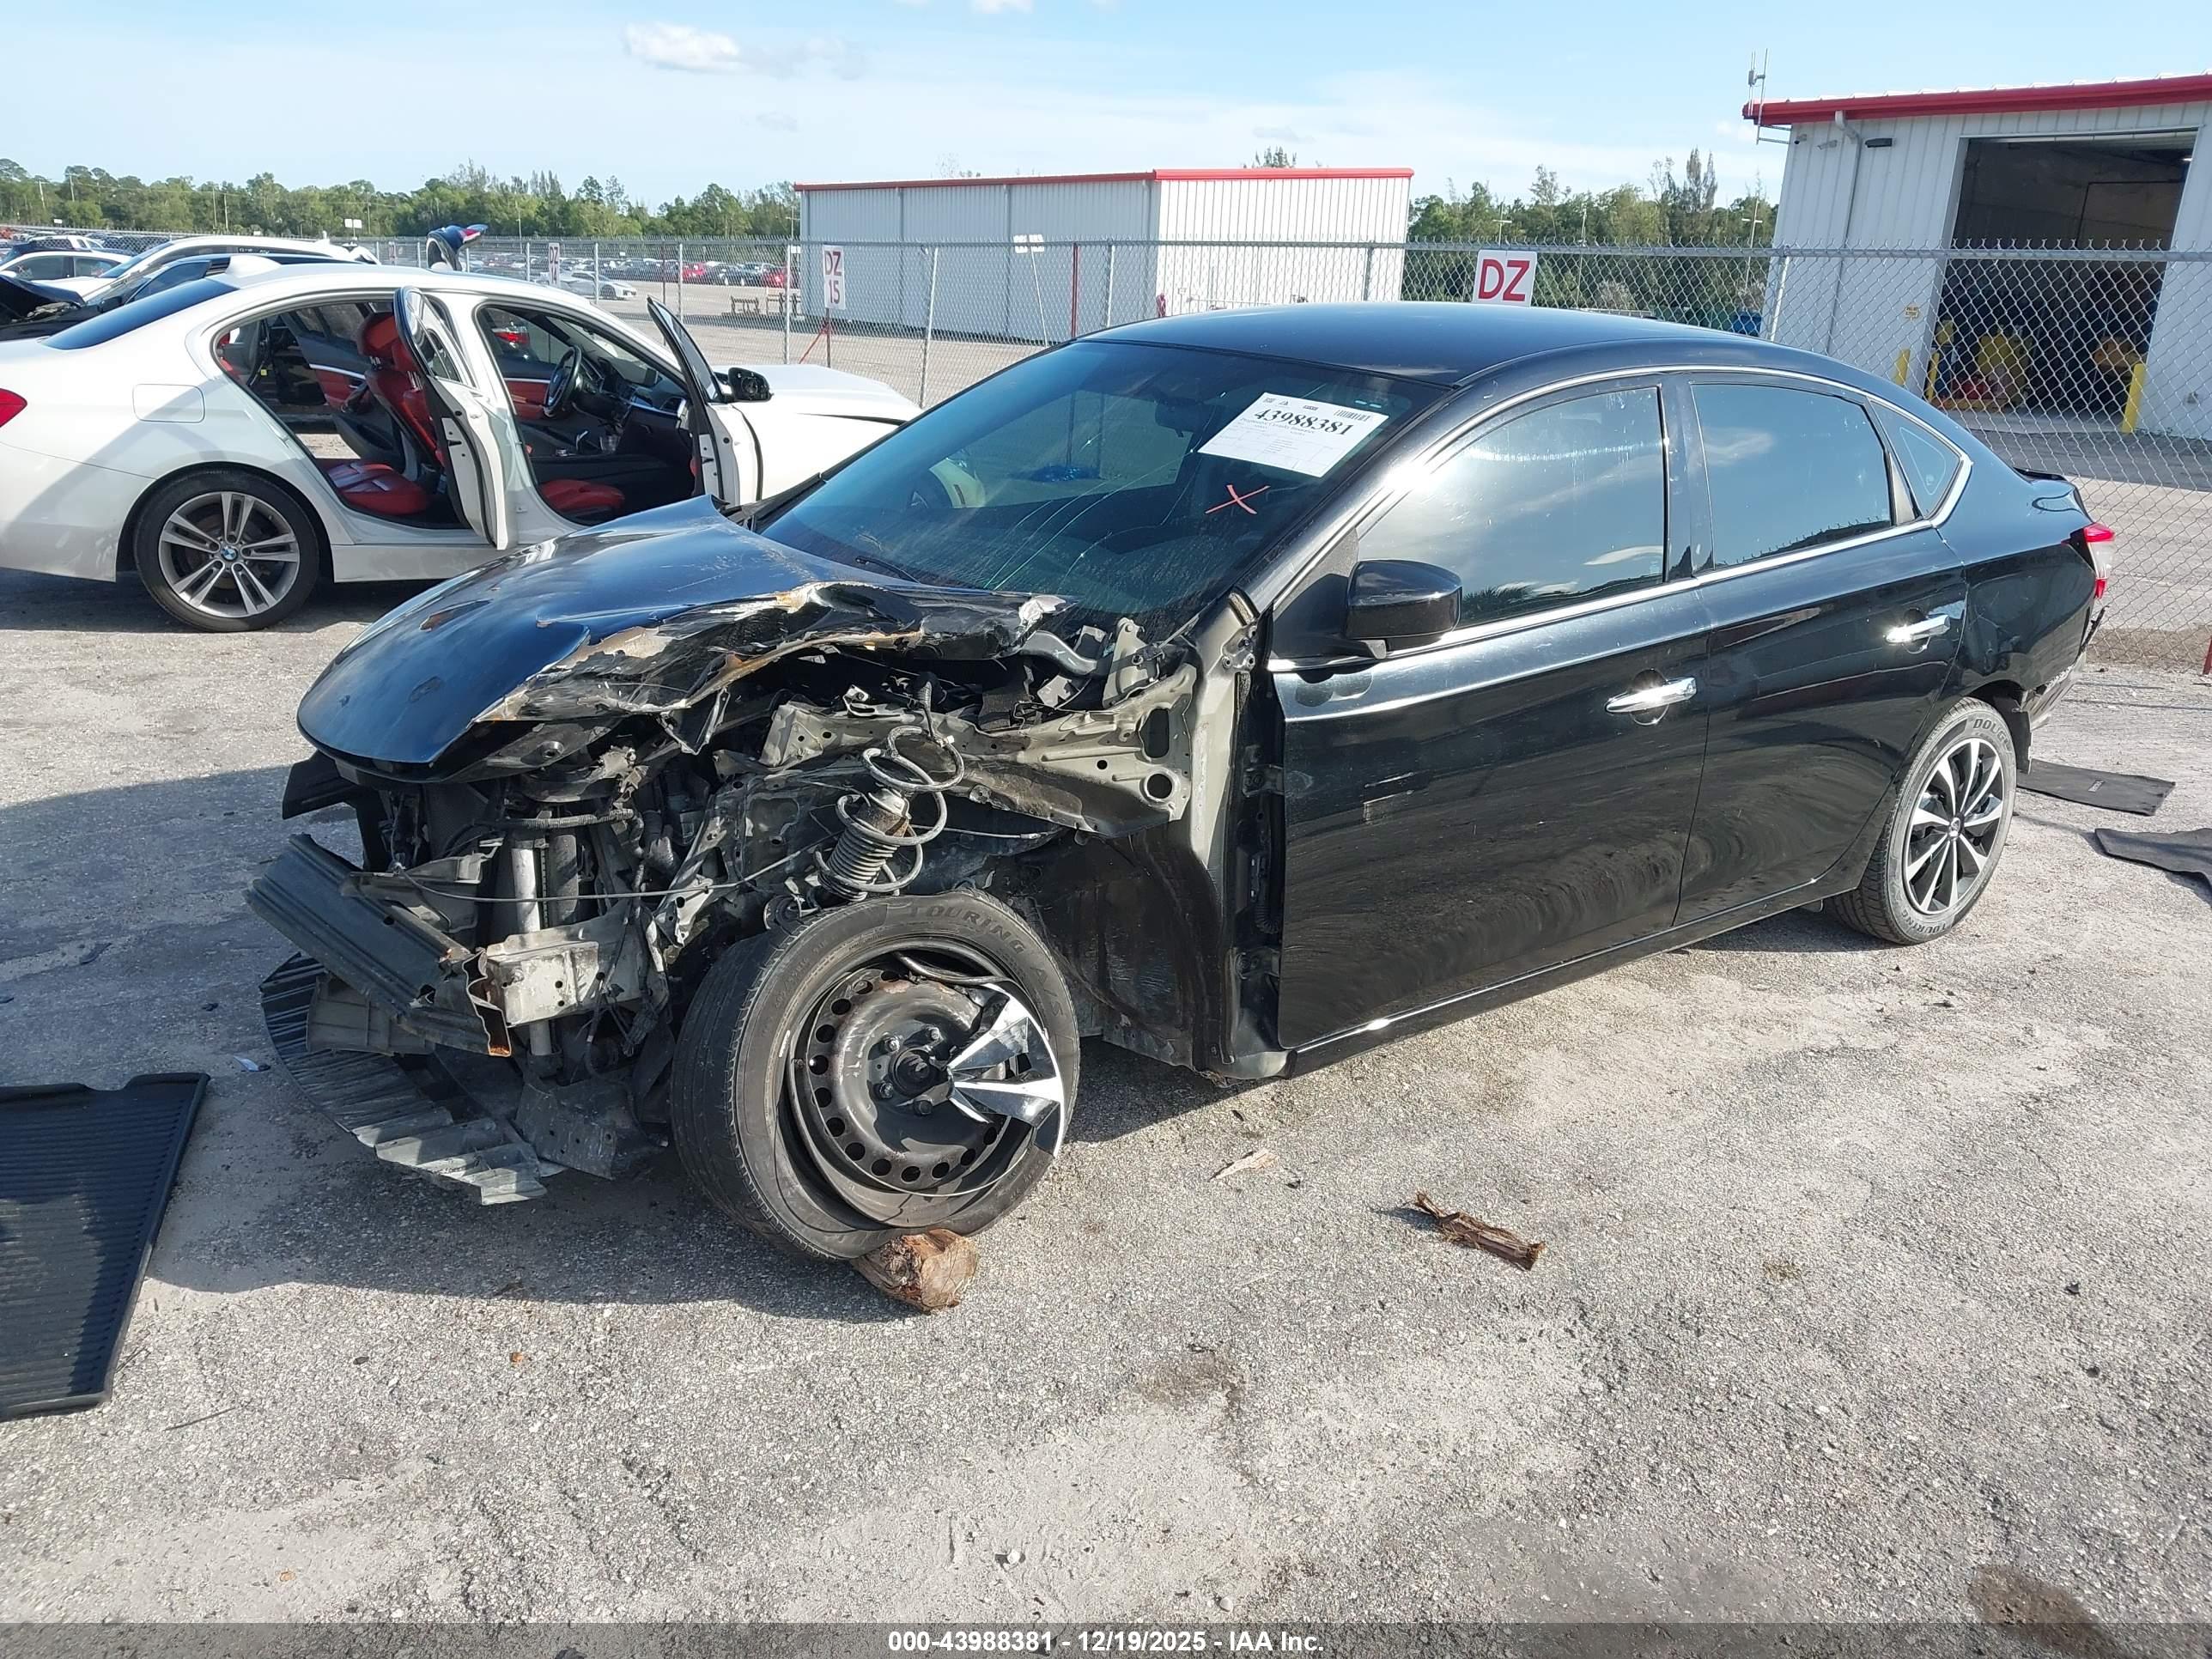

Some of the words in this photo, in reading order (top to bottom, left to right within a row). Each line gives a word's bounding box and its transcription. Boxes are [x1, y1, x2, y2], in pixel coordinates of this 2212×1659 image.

[550, 246, 559, 264] DZ
[824, 251, 842, 276] DZ
[829, 279, 841, 304] 15
[1478, 258, 1530, 301] DZ
[1255, 408, 1353, 435] 43988381
[910, 904, 1027, 955] TOURING
[1901, 908, 1946, 934] TOURING
